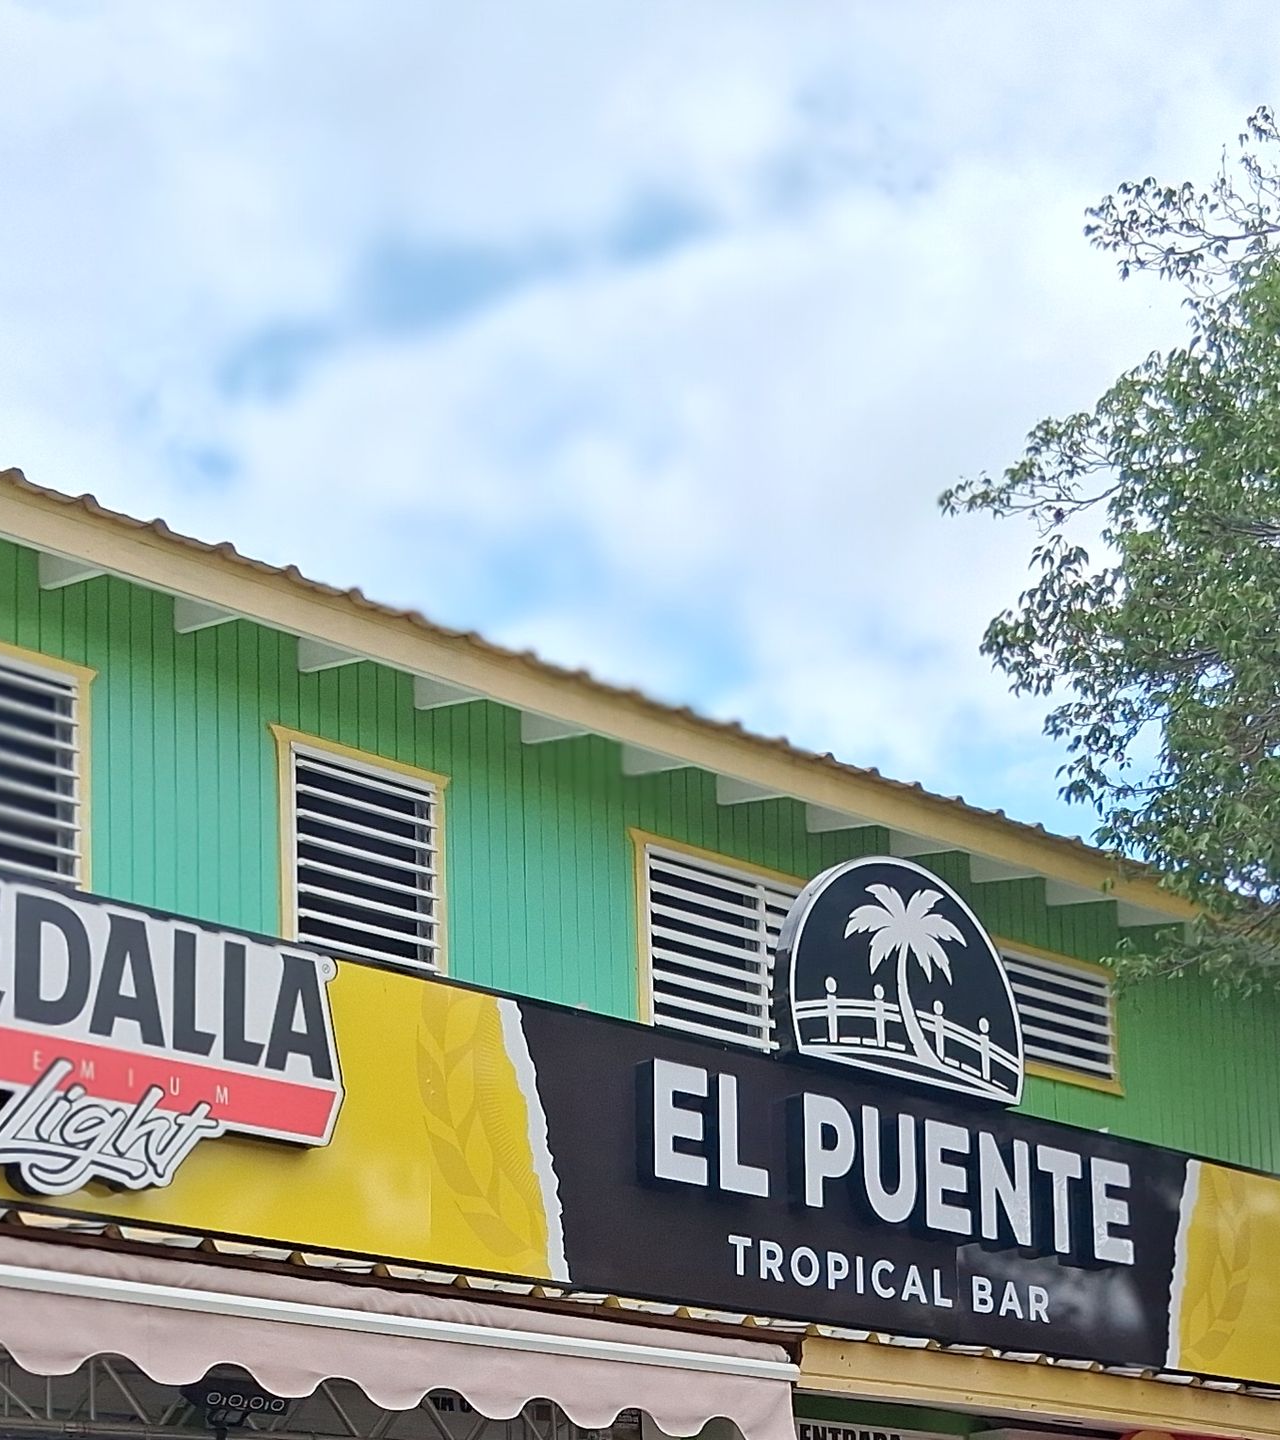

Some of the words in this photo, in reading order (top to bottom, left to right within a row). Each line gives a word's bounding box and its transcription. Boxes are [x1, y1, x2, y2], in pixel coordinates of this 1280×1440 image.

[652, 1057, 770, 1199] EL
[801, 1090, 1136, 1267] PUENTE
[728, 1234, 953, 1309] TROPICAL
[971, 1274, 1052, 1324] BAR
